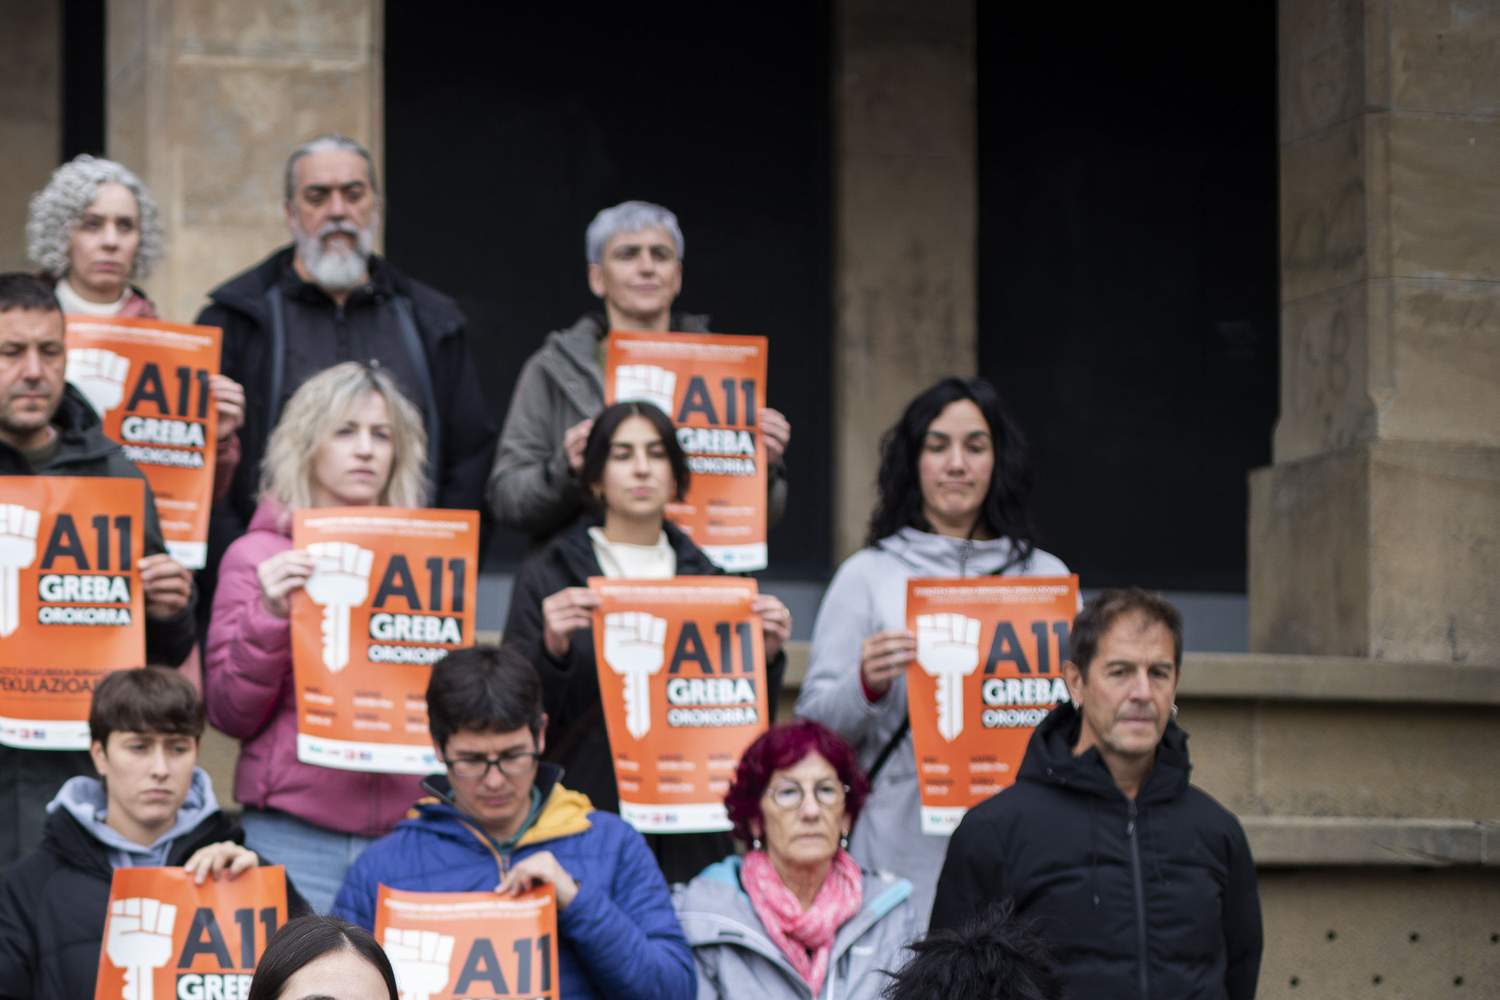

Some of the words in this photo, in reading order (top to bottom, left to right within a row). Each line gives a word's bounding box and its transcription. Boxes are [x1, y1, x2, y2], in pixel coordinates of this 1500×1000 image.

[125, 362, 209, 418] A11
[677, 375, 756, 427] A11
[121, 416, 206, 448] GREBA
[676, 427, 756, 456] GREBA
[40, 514, 132, 571] A11
[39, 575, 131, 604] GREBA
[372, 554, 465, 613] A11
[369, 613, 462, 644] GREBA
[669, 621, 754, 674] A11
[982, 678, 1071, 706] GREBA
[453, 934, 551, 995] A11
